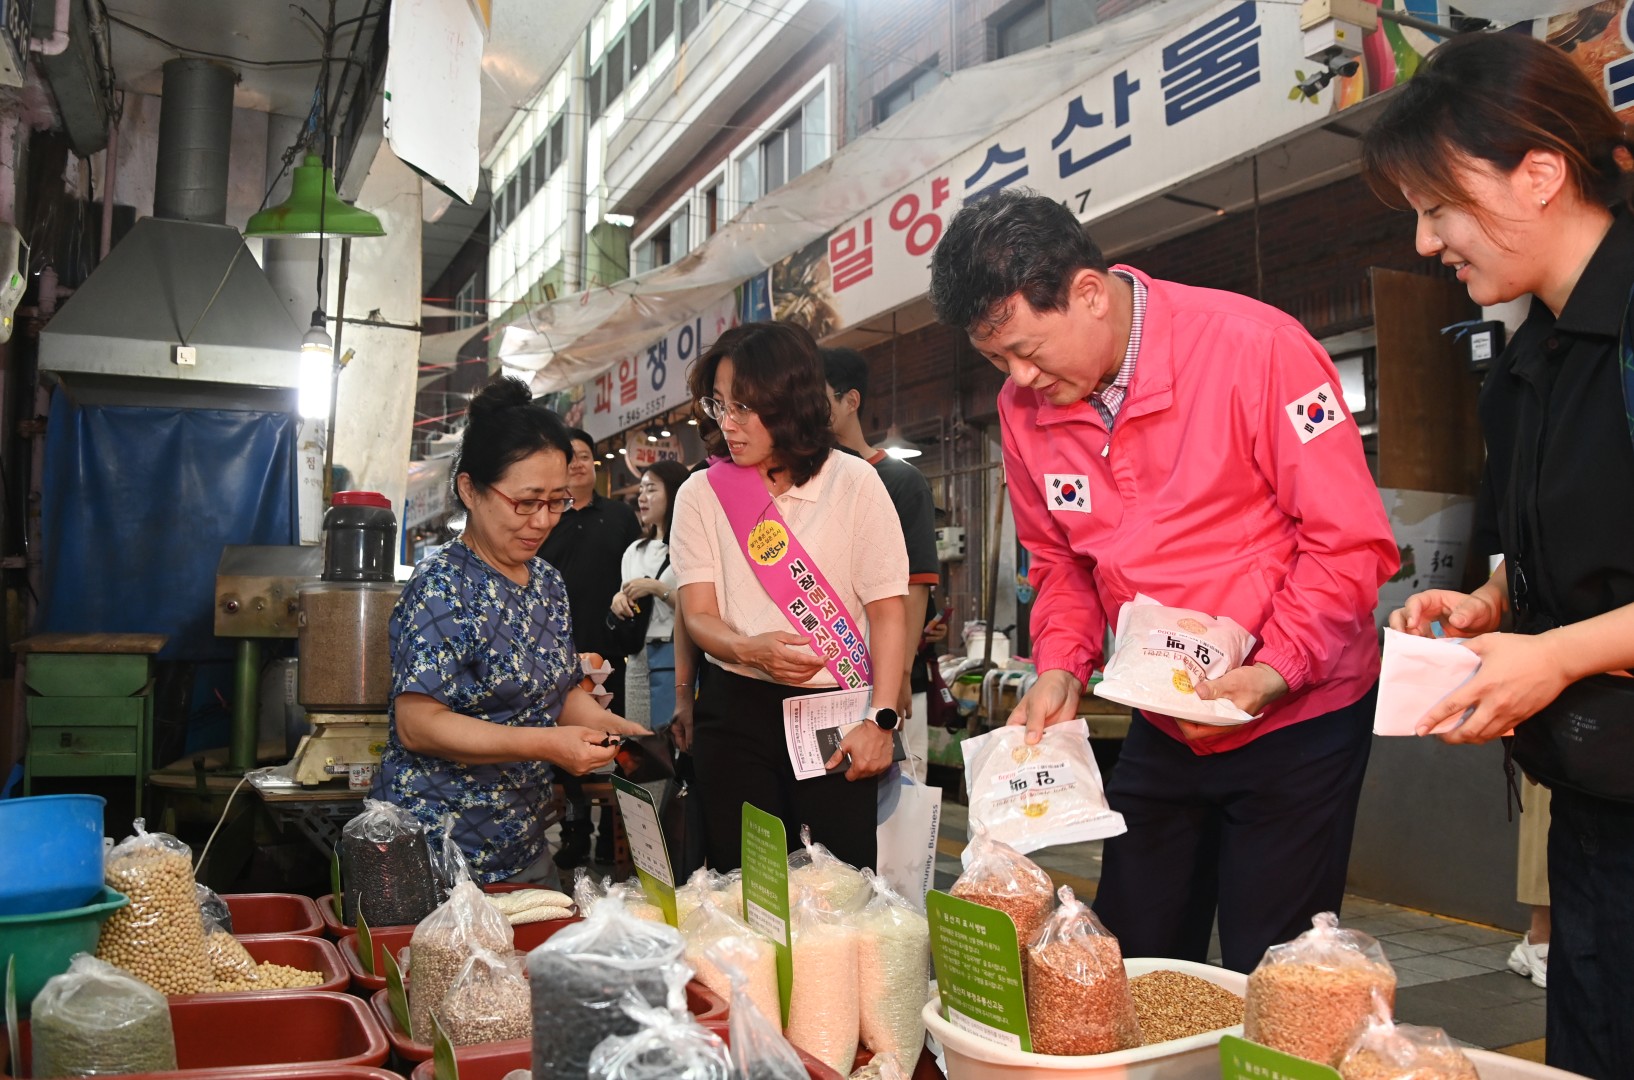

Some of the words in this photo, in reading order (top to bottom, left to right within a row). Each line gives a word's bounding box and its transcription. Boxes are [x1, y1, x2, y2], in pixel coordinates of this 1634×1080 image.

[789, 559, 839, 621] 시장에서
[789, 598, 841, 660] 전통시장
[928, 804, 938, 848] Business
